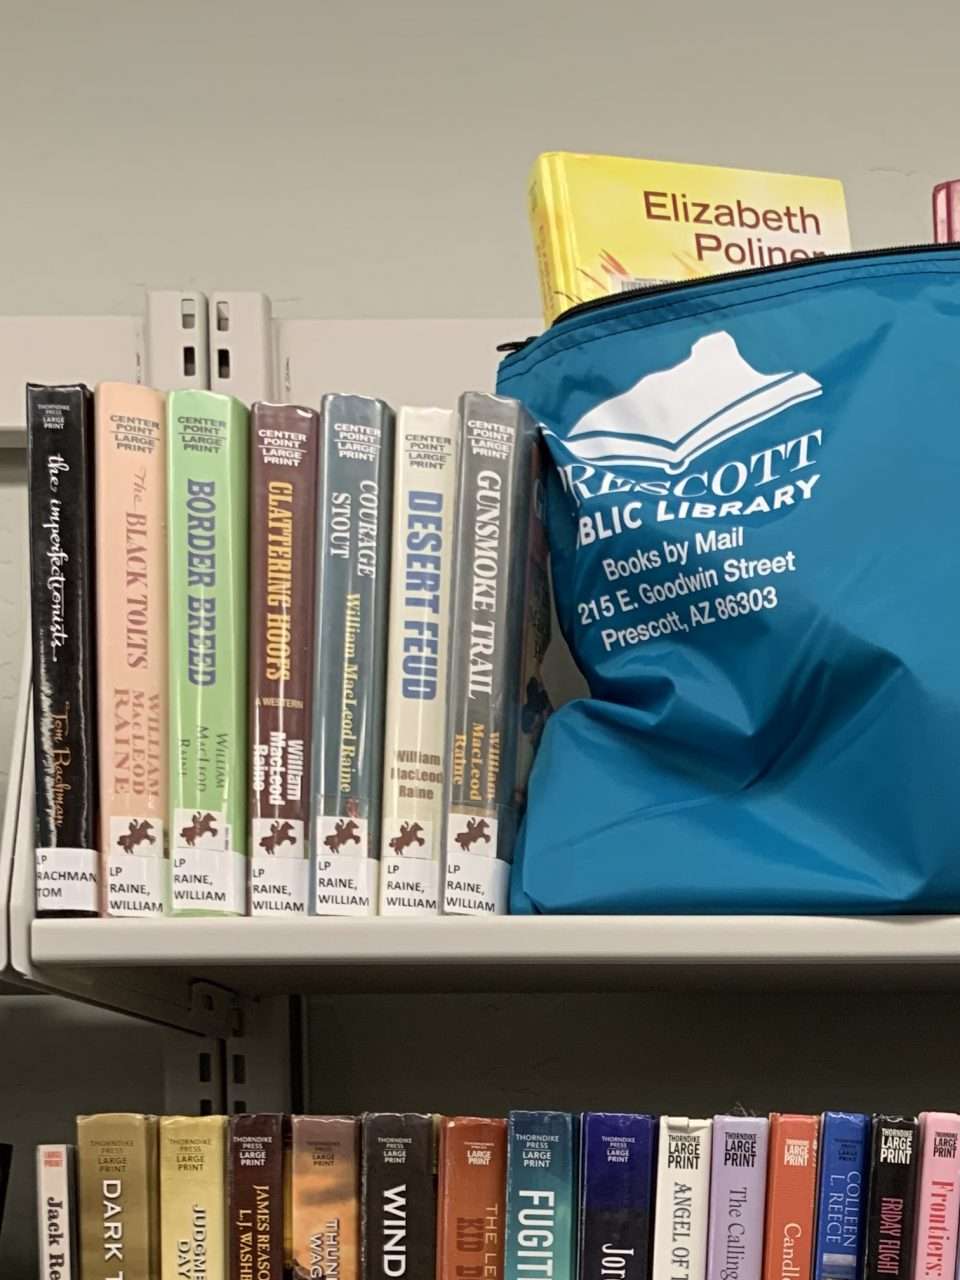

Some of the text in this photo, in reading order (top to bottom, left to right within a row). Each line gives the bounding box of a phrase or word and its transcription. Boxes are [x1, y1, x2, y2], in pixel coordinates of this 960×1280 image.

[643, 190, 821, 236] Elizabeth
[110, 415, 159, 428] CENTER
[114, 436, 155, 445] LARGE
[116, 423, 153, 435] POINT
[117, 443, 153, 454] PRINT
[578, 474, 820, 547] BLIC LIBRARY
[42, 455, 70, 663] the imperfectionists
[602, 527, 744, 580] Books by Mail
[185, 478, 217, 687] BORDER BREED
[266, 481, 292, 682] CLATTERING HOOFS
[401, 490, 443, 700] DESERT FEUD
[469, 469, 502, 699] GUNSMOKE TRAIL
[578, 551, 796, 624] 215 E. Goodwin Street
[601, 586, 777, 651] Prescott, AZ 86303
[36, 887, 63, 898] TOM
[110, 883, 149, 896] RAINE,
[110, 898, 162, 912] WILLIAM
[47, 1196, 64, 1245] Jack
[102, 1180, 121, 1259] DARK
[727, 1186, 749, 1218] The
[382, 1185, 407, 1276] WIND
[177, 1239, 190, 1279] DAY
